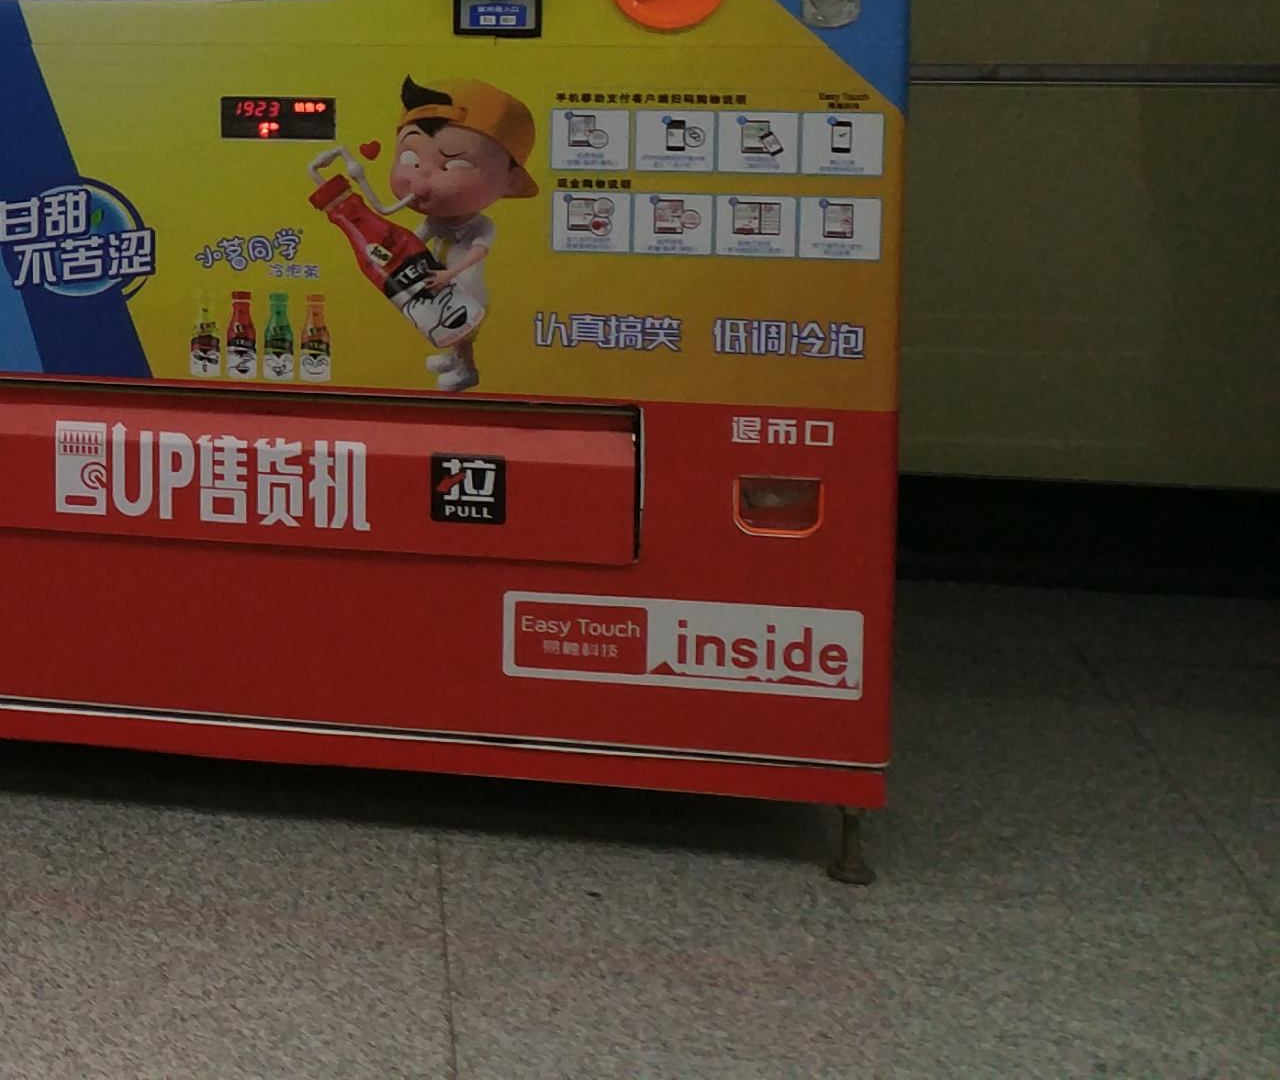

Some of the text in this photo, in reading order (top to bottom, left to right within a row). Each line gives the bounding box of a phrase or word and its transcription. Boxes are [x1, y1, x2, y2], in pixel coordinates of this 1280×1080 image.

[235, 101, 281, 117] 1923
[12, 230, 155, 288] 不苦涩
[194, 227, 302, 271] 小茗同学
[534, 311, 866, 360] 认真搞笑 低调冷泡
[731, 416, 836, 449] 退币口
[111, 422, 371, 534] UP售货机
[438, 456, 498, 504] 拉
[444, 504, 495, 520] PULL
[521, 614, 642, 642] Easy Touch
[676, 618, 849, 678] inside
